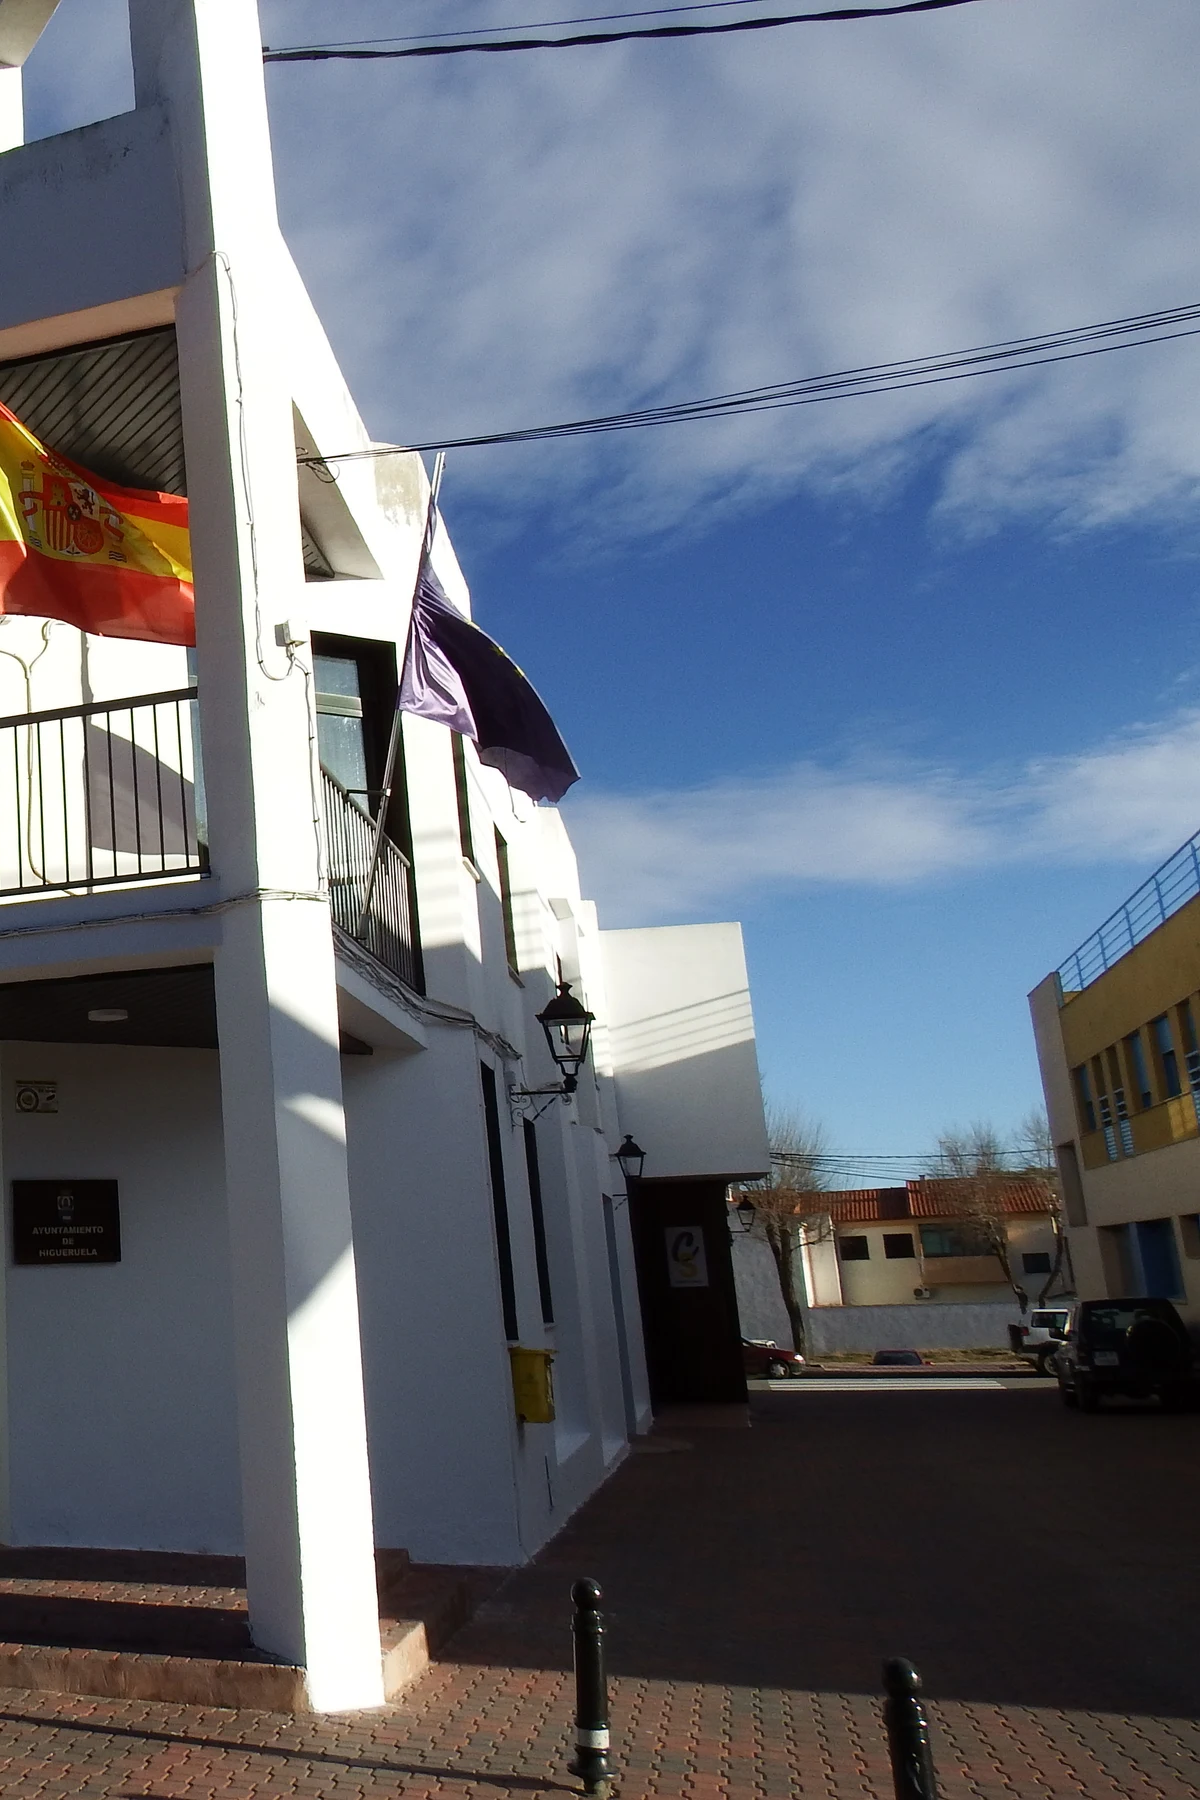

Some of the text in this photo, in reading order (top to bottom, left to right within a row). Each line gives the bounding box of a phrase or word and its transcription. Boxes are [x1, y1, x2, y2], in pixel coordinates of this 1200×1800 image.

[32, 1226, 104, 1235] AYUNTAMIENTO
[62, 1237, 75, 1246] DE
[39, 1248, 98, 1257] HIGUERUELA
